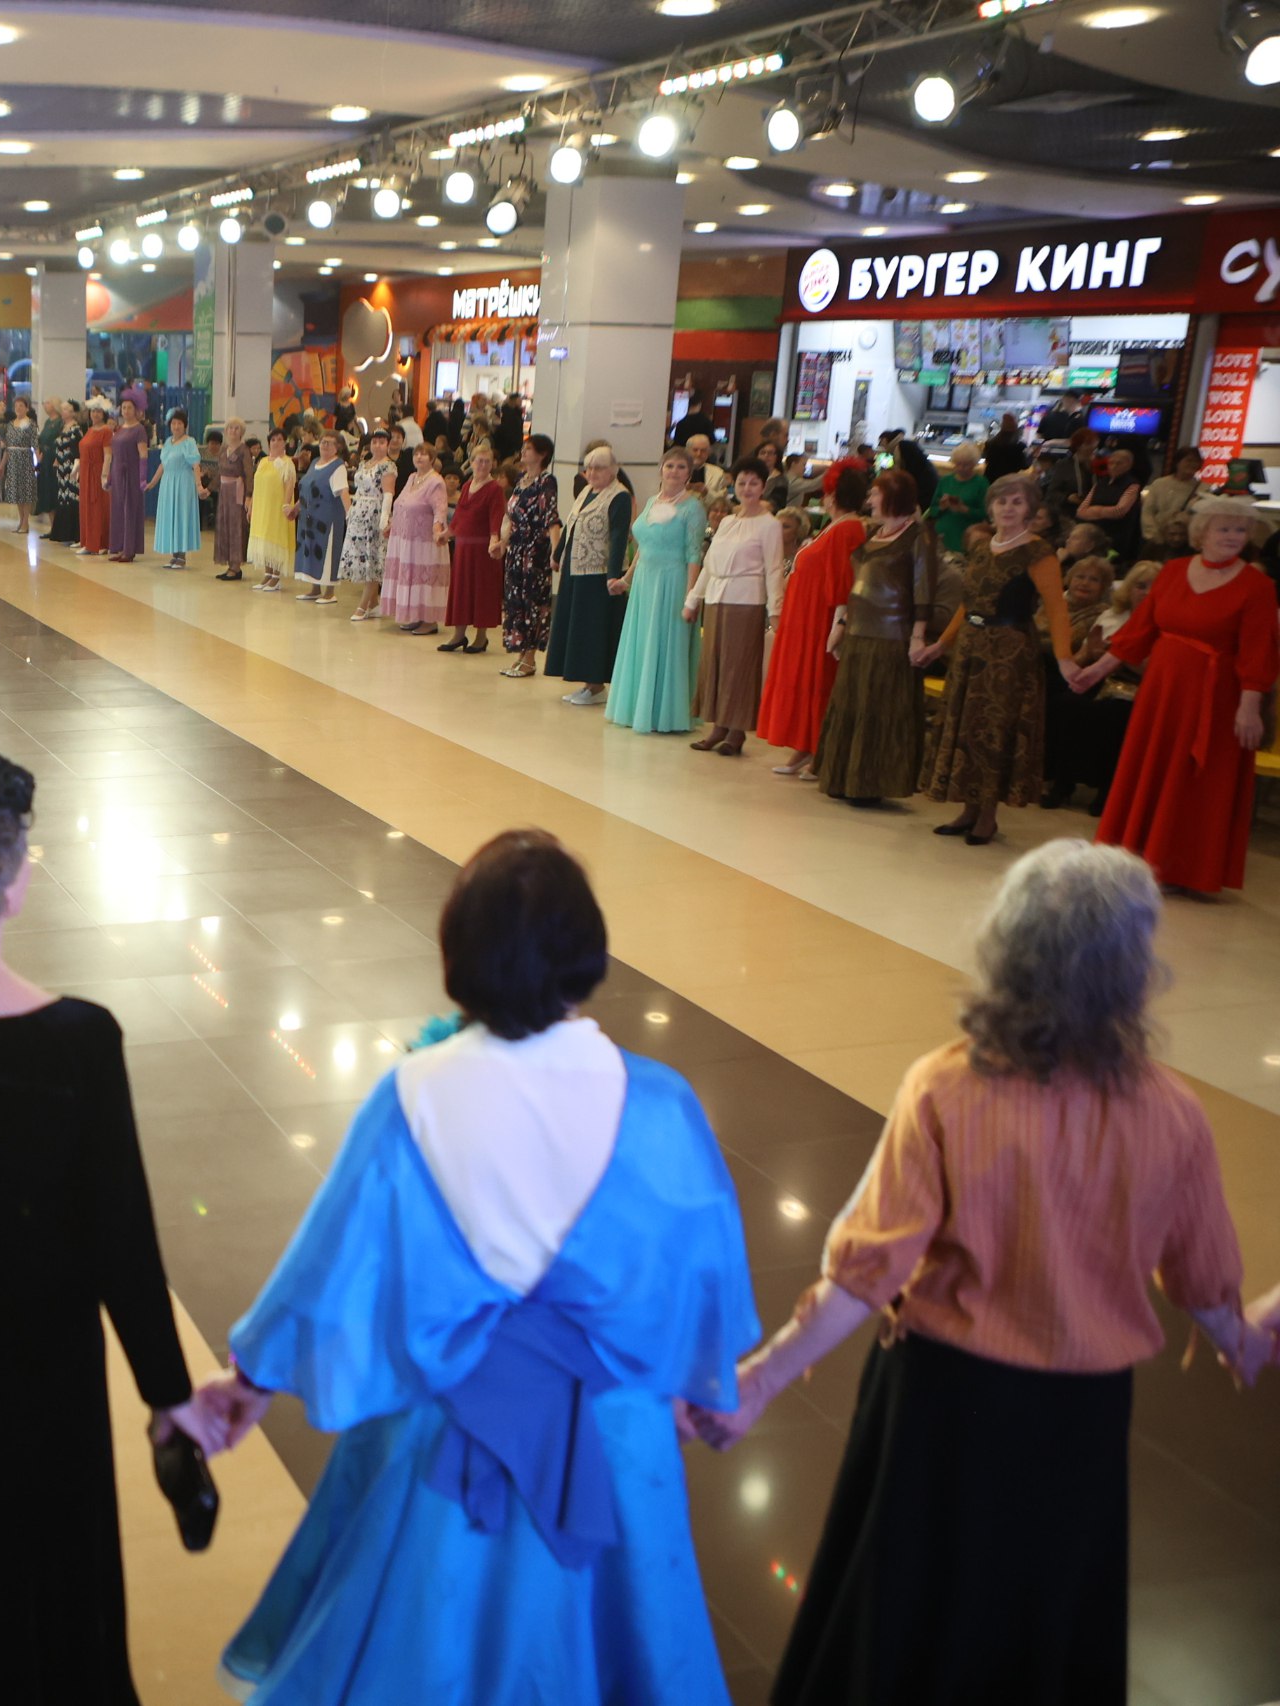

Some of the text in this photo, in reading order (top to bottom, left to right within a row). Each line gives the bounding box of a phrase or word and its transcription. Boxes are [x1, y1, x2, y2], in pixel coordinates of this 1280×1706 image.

[848, 250, 1000, 300] БУРГЕР
[1015, 237, 1162, 293] КИНГ
[1214, 353, 1253, 369] LOVE
[1210, 372, 1249, 387] ROLL
[1207, 391, 1244, 406] WOK
[1203, 409, 1242, 424] LOVE
[1200, 427, 1238, 442] ROLL
